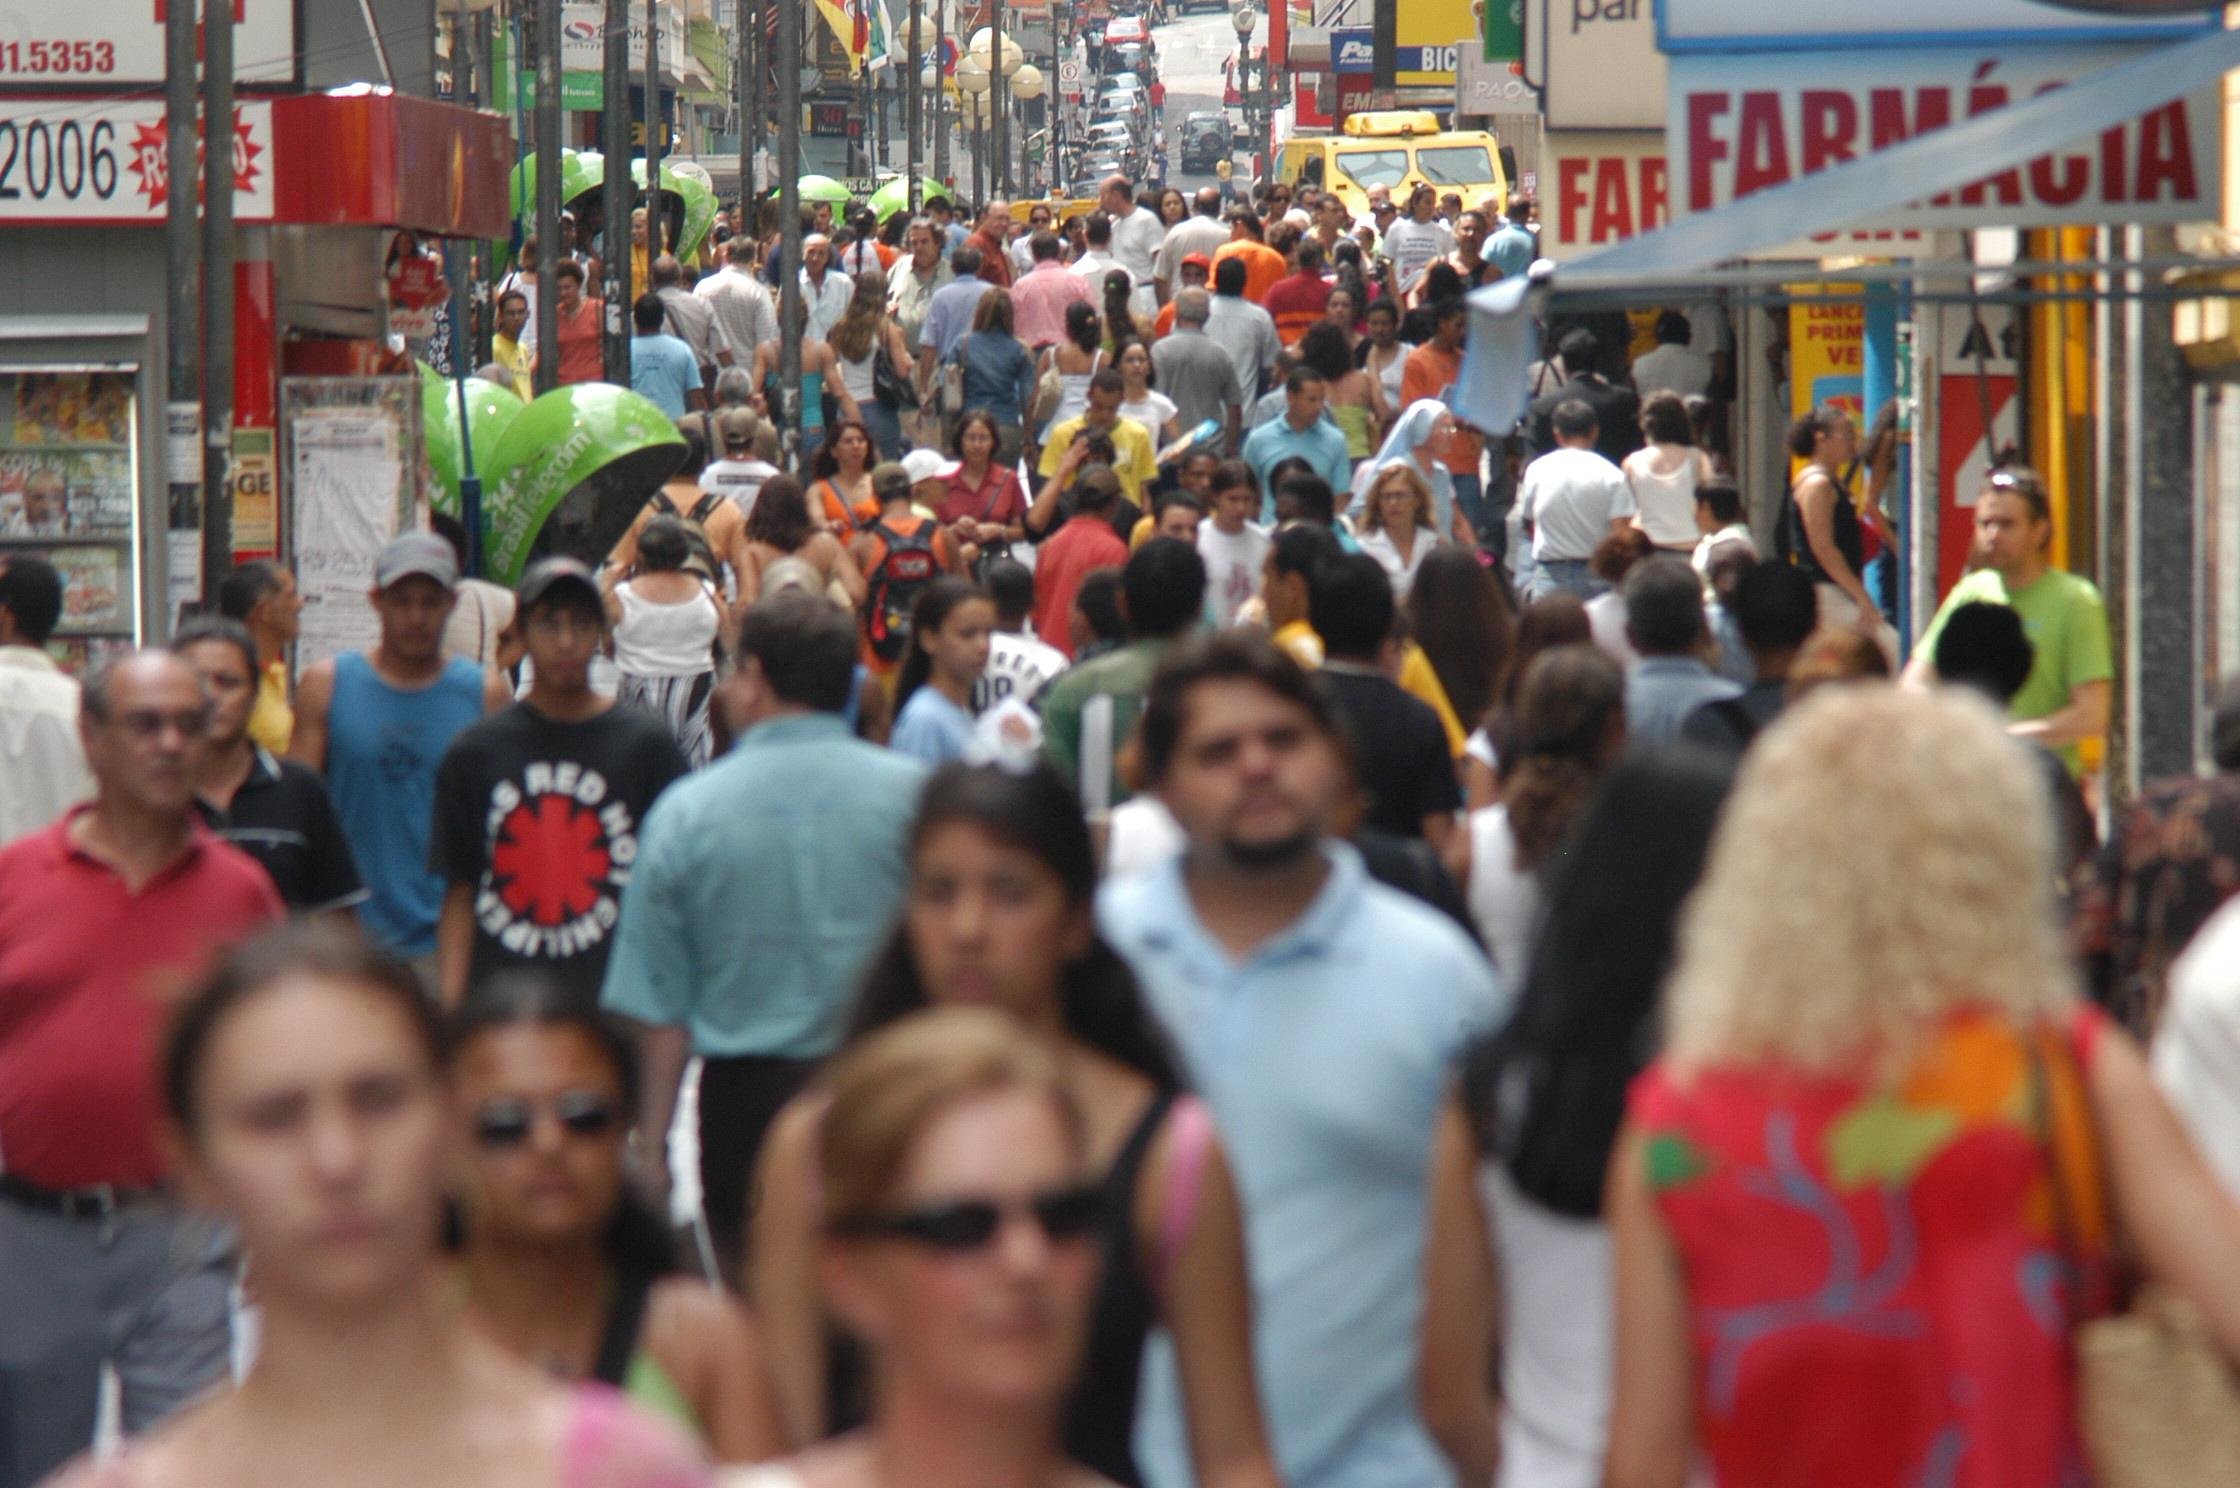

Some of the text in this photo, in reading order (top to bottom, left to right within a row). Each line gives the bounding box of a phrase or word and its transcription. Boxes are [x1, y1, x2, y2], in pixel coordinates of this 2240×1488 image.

[0, 118, 118, 200] 2006
[1686, 59, 2199, 214] FARMÁCIA
[524, 761, 608, 806] RED
